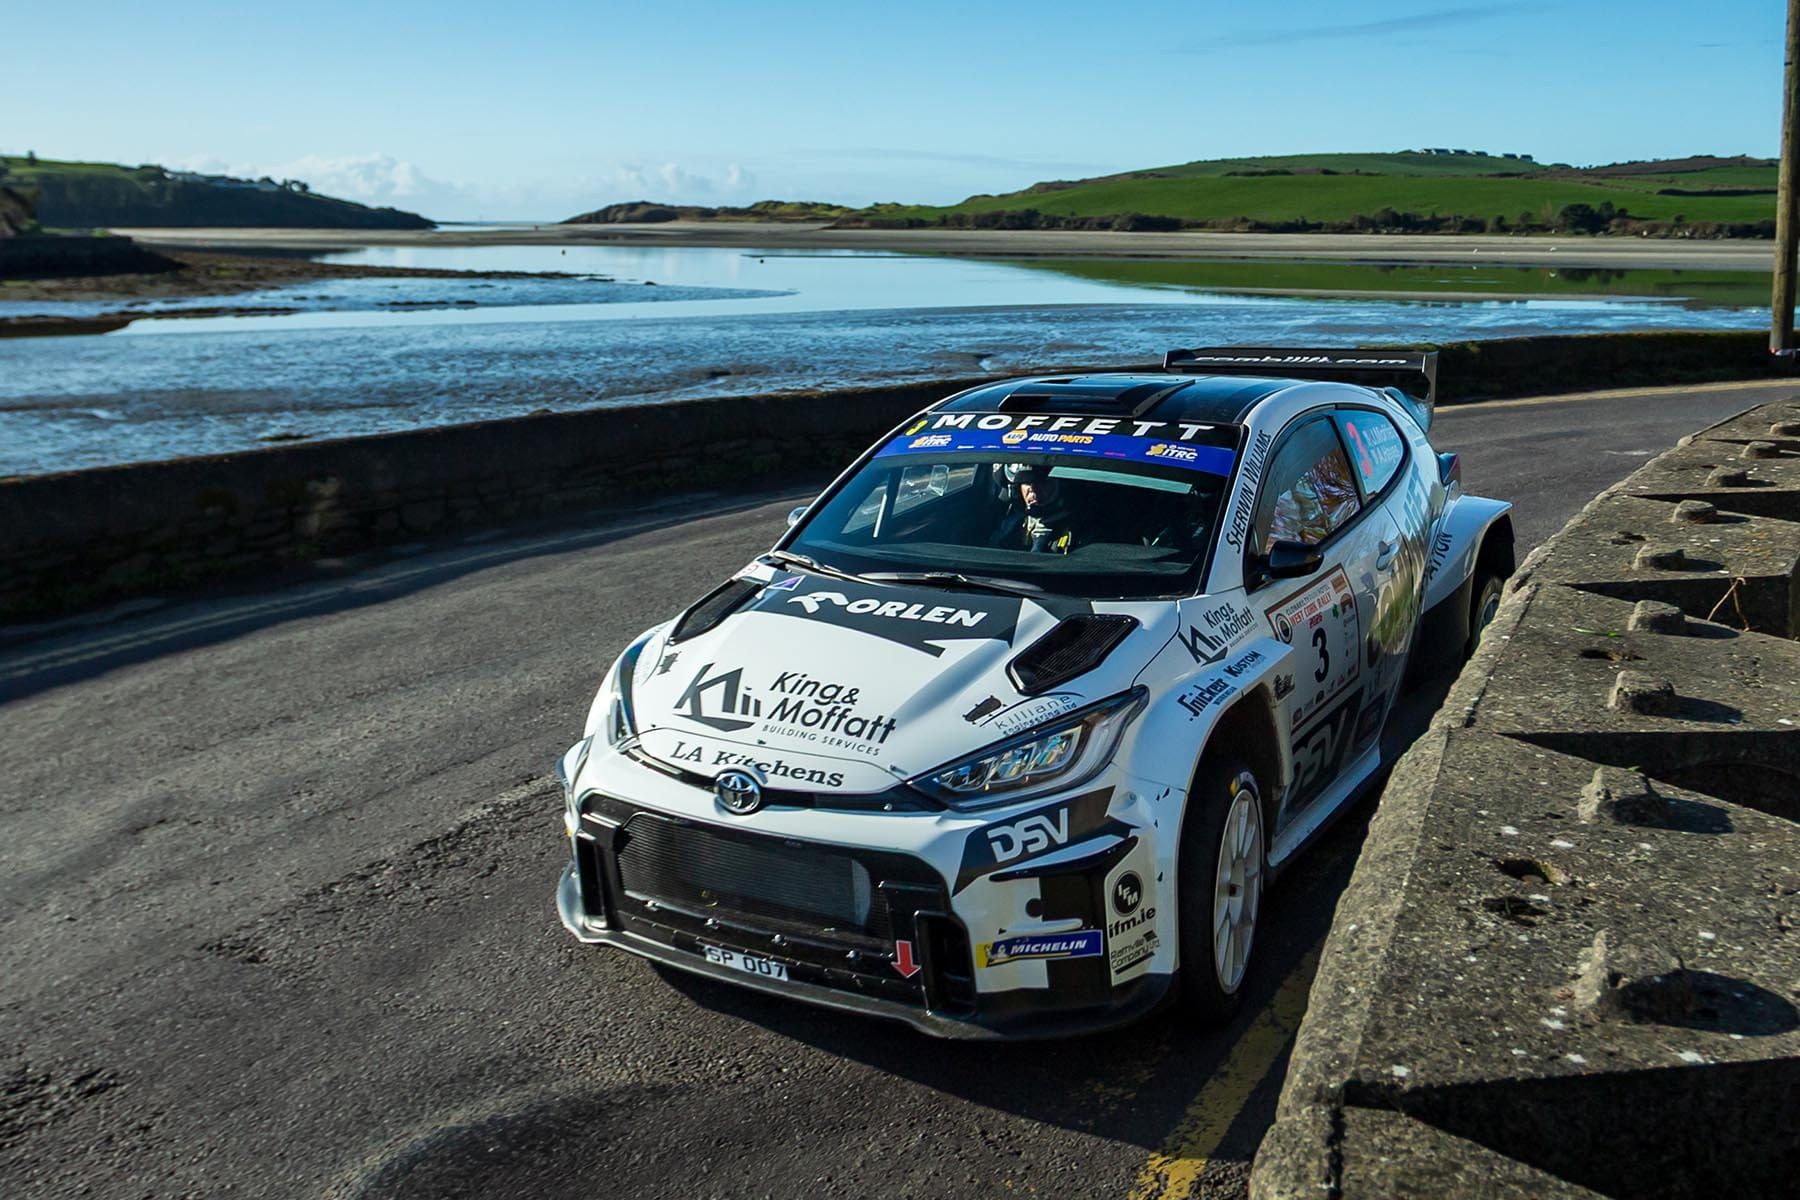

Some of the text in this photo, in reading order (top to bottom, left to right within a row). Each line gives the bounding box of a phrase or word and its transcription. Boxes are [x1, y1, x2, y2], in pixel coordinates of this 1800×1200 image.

[932, 414, 1215, 441] MOFFETT
[1028, 433, 1059, 442] AUTO
[1057, 434, 1094, 444] PARTS
[1162, 448, 1198, 459] ITRC
[1226, 429, 1272, 554] SHERWIN WILLIAMS
[846, 598, 988, 627] ORLEN
[1219, 606, 1255, 641] Moffatt
[1288, 609, 1304, 626] WEST
[1312, 627, 1330, 684] 3
[767, 696, 897, 745] Moffatt
[762, 724, 881, 757] BUILDING SERVICES
[670, 741, 844, 788] LA Kitchens
[987, 808, 1069, 863] DSV
[1118, 883, 1139, 906] IFM
[1108, 907, 1156, 939] ifm.ie
[707, 947, 784, 978] SP 007
[1010, 939, 1088, 955] MICHELIN
